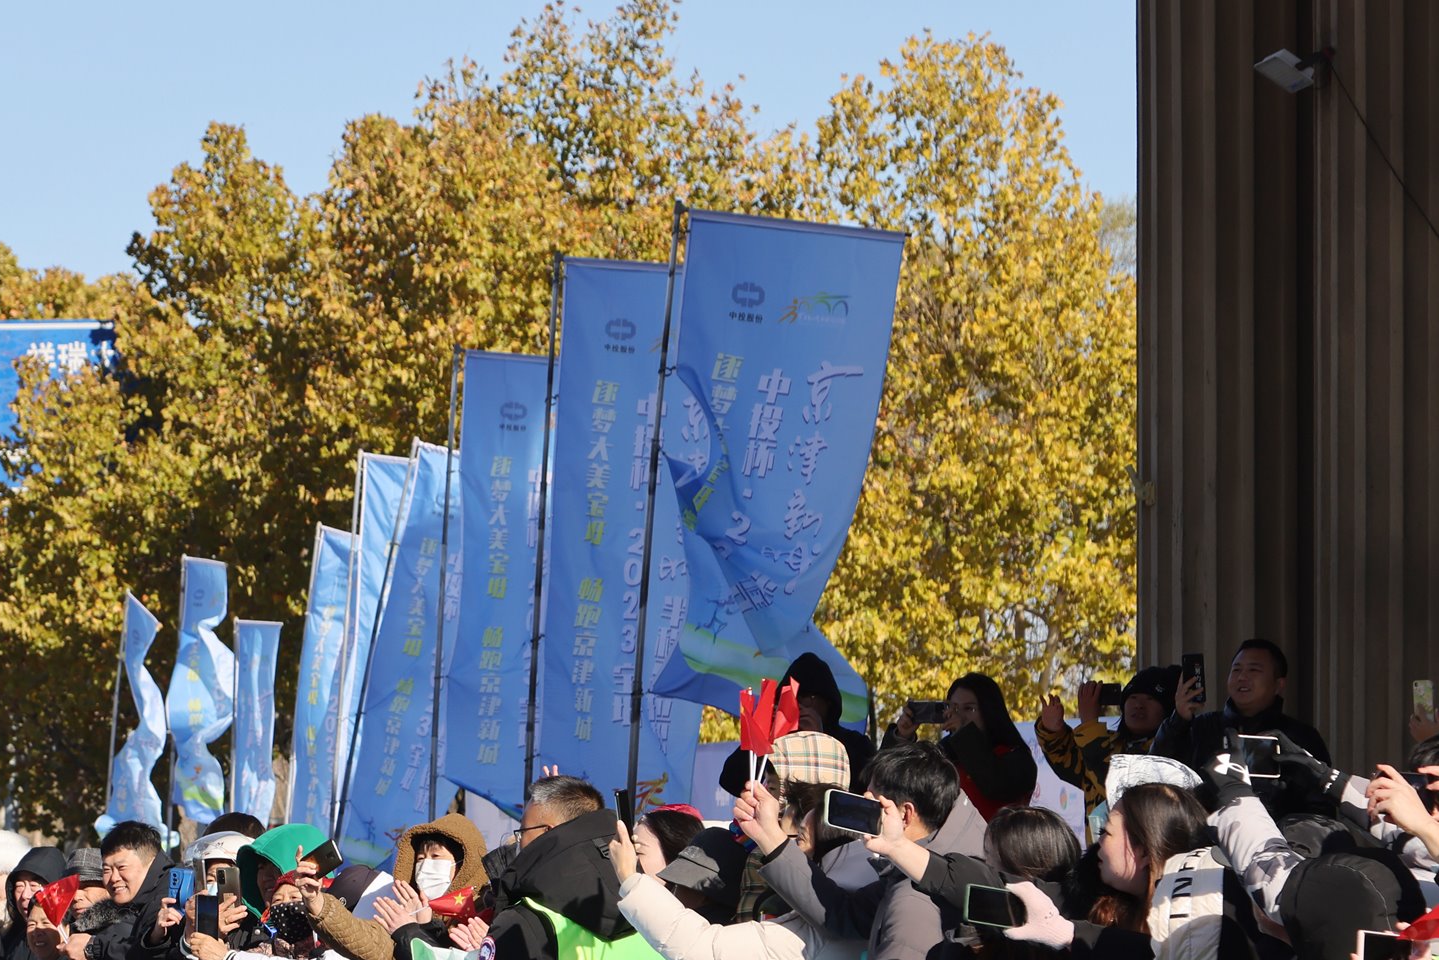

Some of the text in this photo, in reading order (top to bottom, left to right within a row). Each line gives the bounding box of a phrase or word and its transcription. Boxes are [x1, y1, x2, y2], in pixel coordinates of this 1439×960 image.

[728, 311, 764, 324] 中投股份
[603, 343, 636, 354] 中投股份
[572, 379, 621, 742] 逐梦大美宝坻 畅跑京津新城
